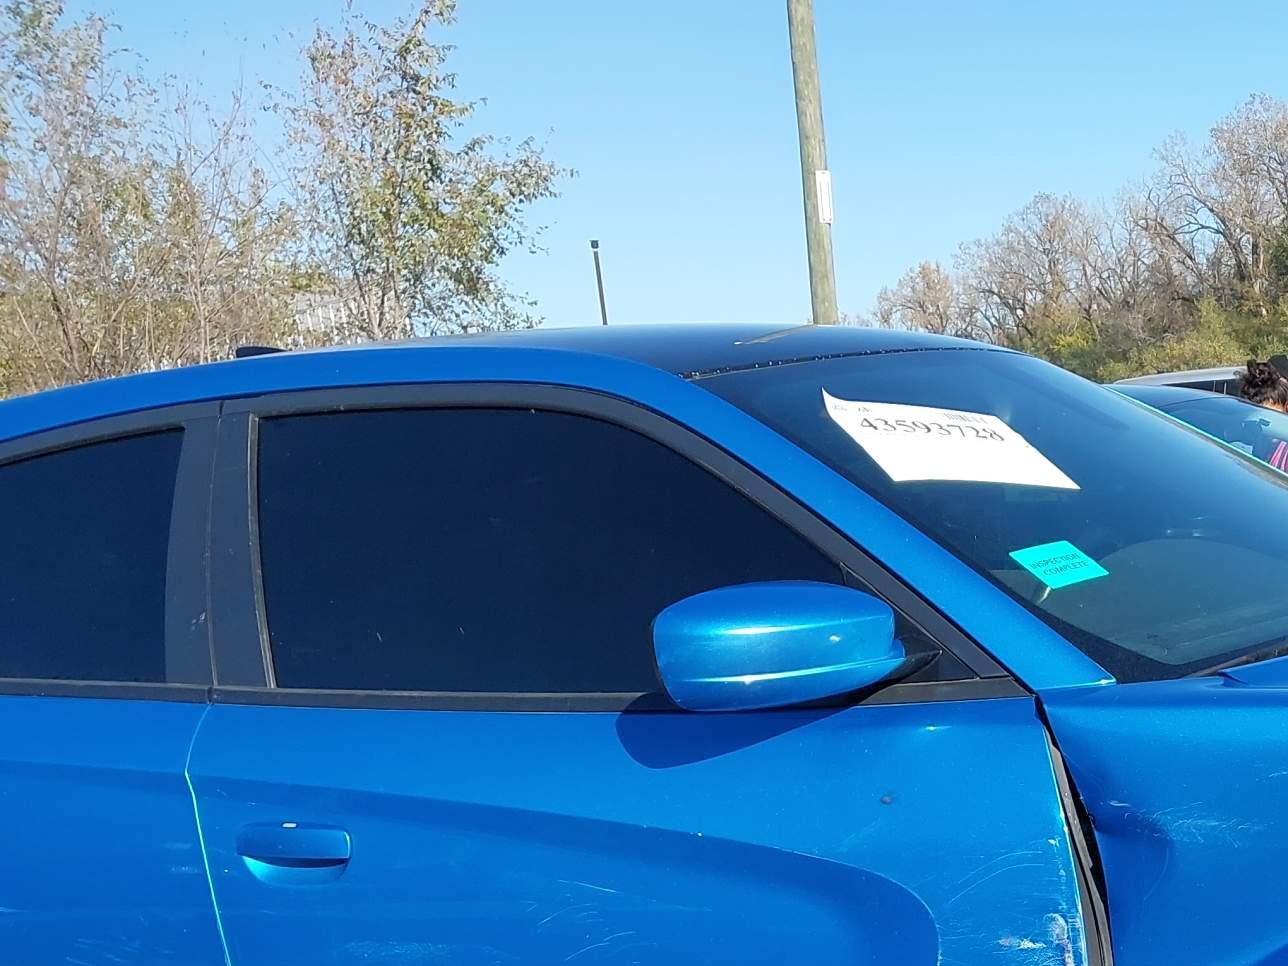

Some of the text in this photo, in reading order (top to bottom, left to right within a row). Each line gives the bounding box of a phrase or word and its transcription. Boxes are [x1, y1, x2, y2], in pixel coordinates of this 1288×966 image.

[859, 417, 1005, 442] 43593728
[1030, 552, 1081, 569] INSPECTION
[1043, 560, 1089, 576] COMPLETE
